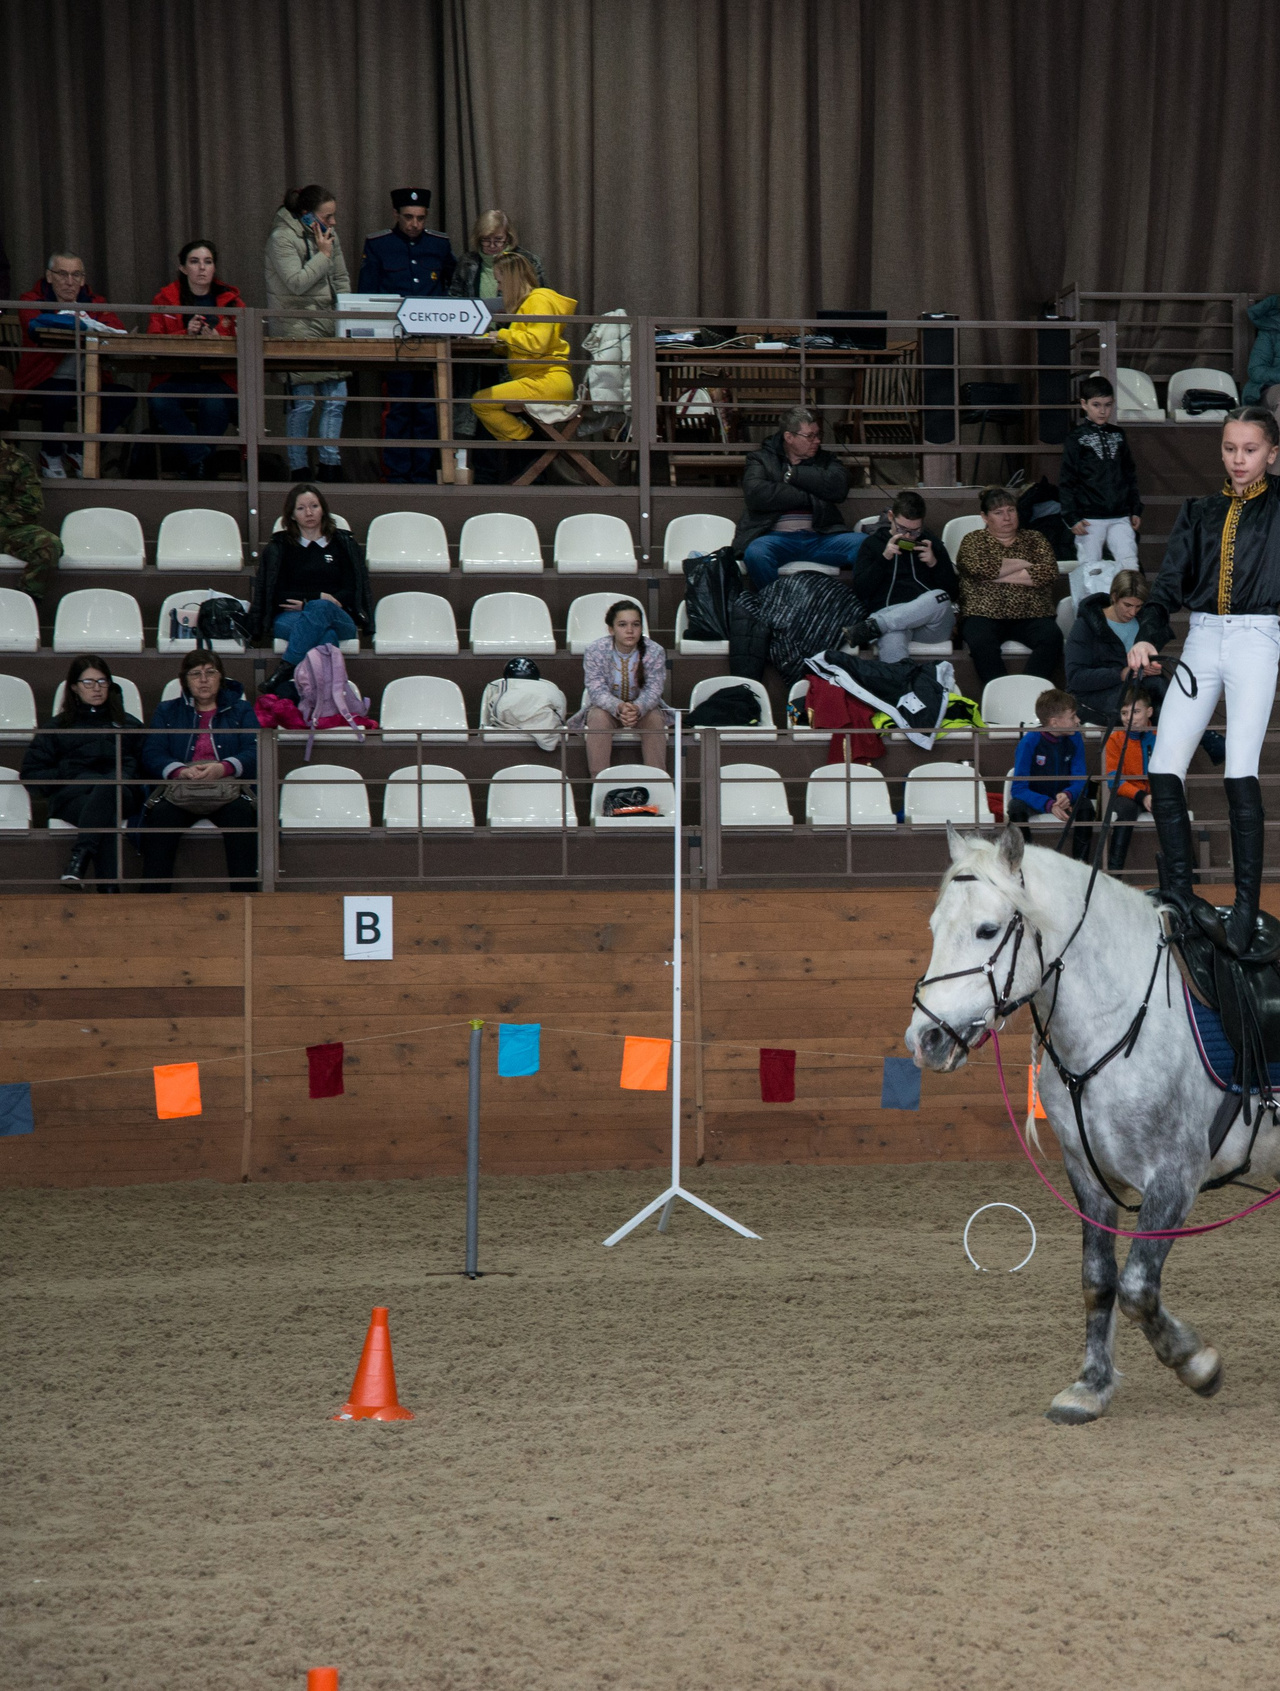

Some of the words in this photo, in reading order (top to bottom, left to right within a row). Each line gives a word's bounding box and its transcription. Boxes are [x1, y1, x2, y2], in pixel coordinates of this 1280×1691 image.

[409, 311, 456, 322] СЕКТОР
[459, 310, 470, 323] D
[356, 911, 381, 945] B
